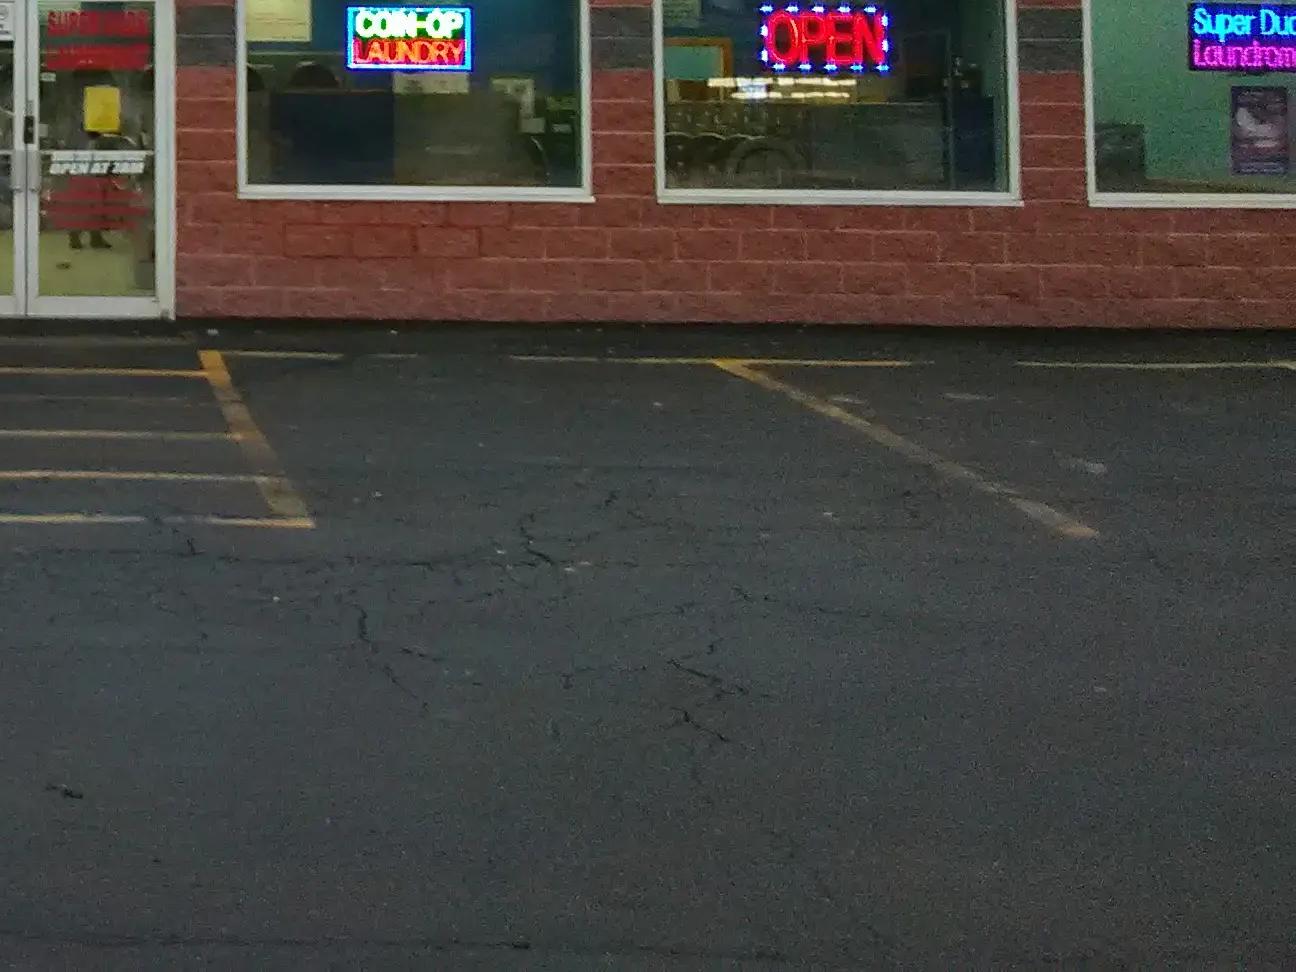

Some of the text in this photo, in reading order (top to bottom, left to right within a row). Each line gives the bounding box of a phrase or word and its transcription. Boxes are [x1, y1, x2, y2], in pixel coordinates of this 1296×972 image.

[355, 8, 464, 39] COIN-OP
[766, 9, 885, 65] OPEN
[1192, 6, 1257, 43] Super
[353, 38, 466, 65] LAUNDRY
